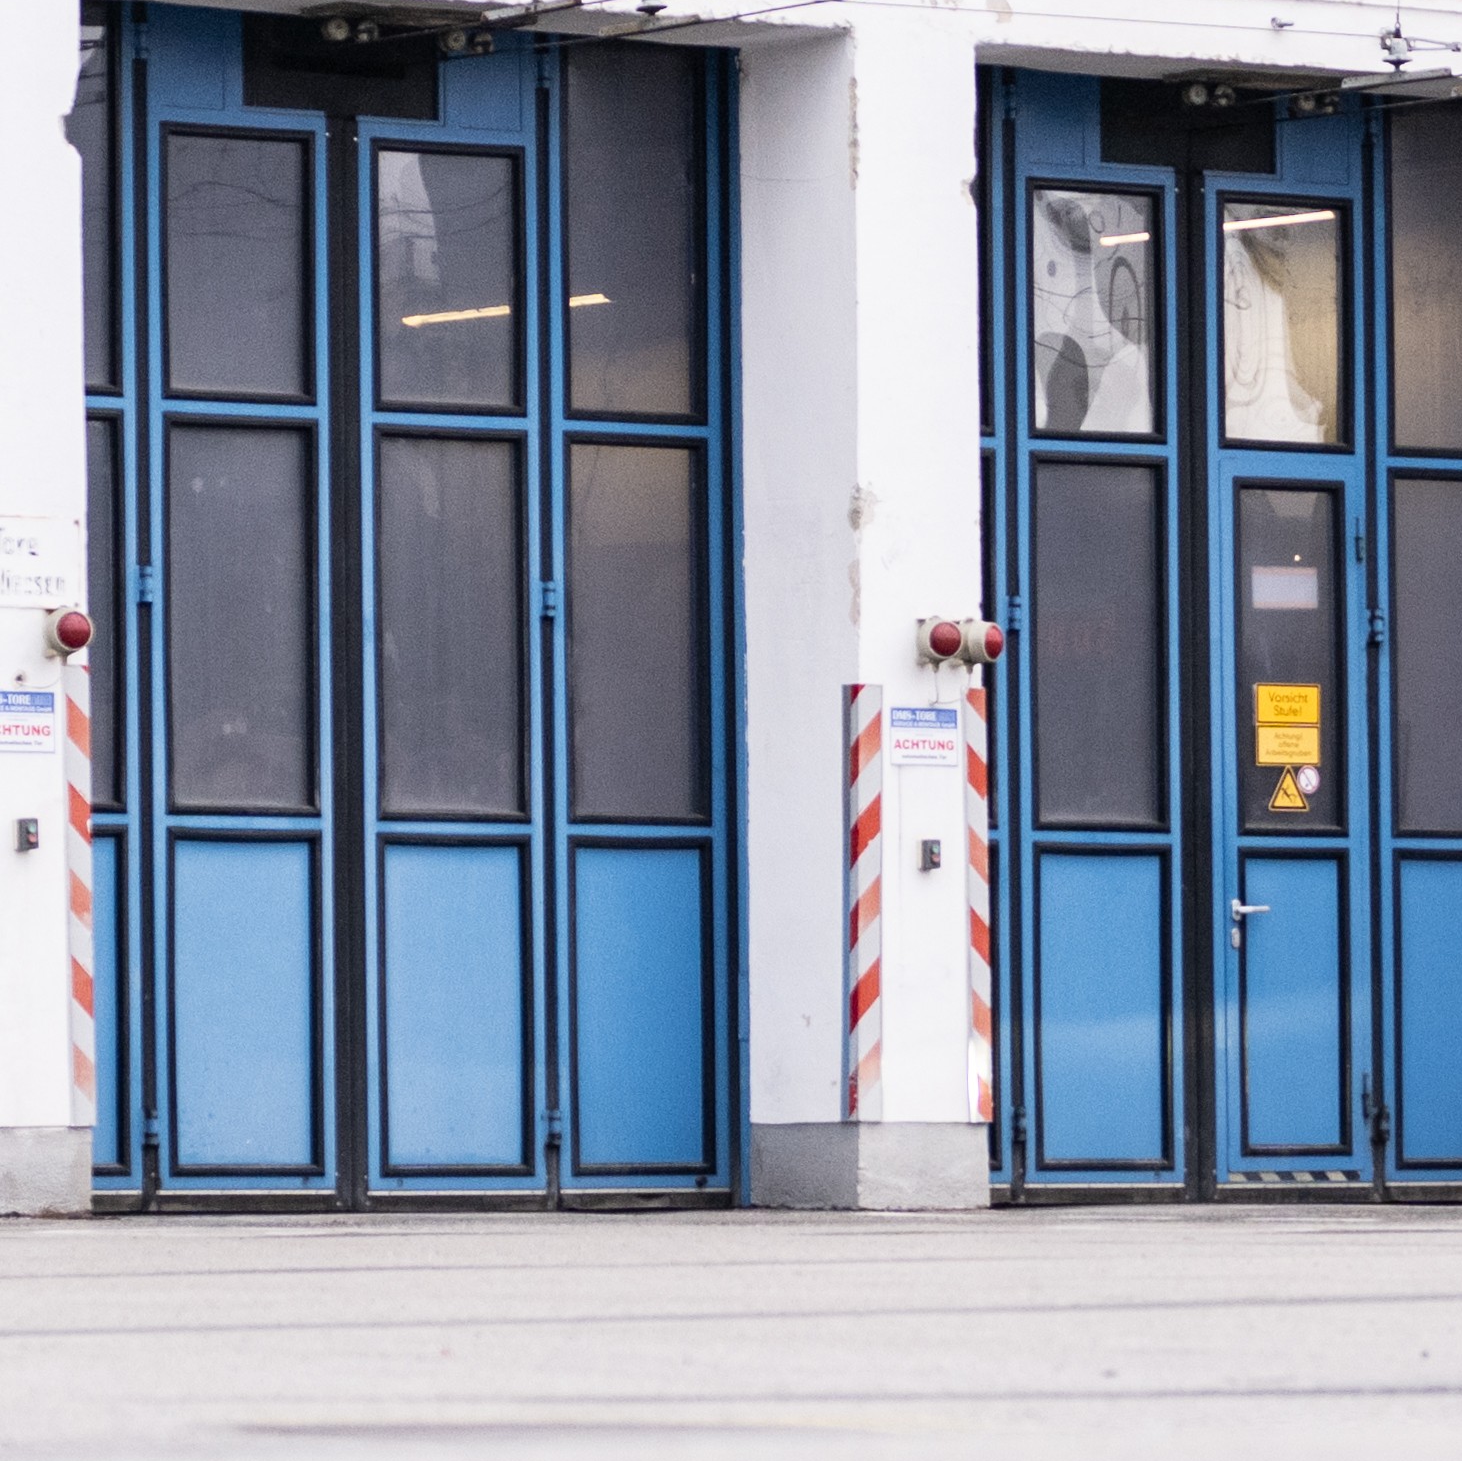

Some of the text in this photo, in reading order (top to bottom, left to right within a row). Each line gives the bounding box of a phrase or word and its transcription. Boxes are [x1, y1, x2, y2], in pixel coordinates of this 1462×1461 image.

[1268, 691, 1308, 703] Vorsicht
[1273, 705, 1303, 716] Stufe!
[895, 739, 954, 751] ACHTUNG
